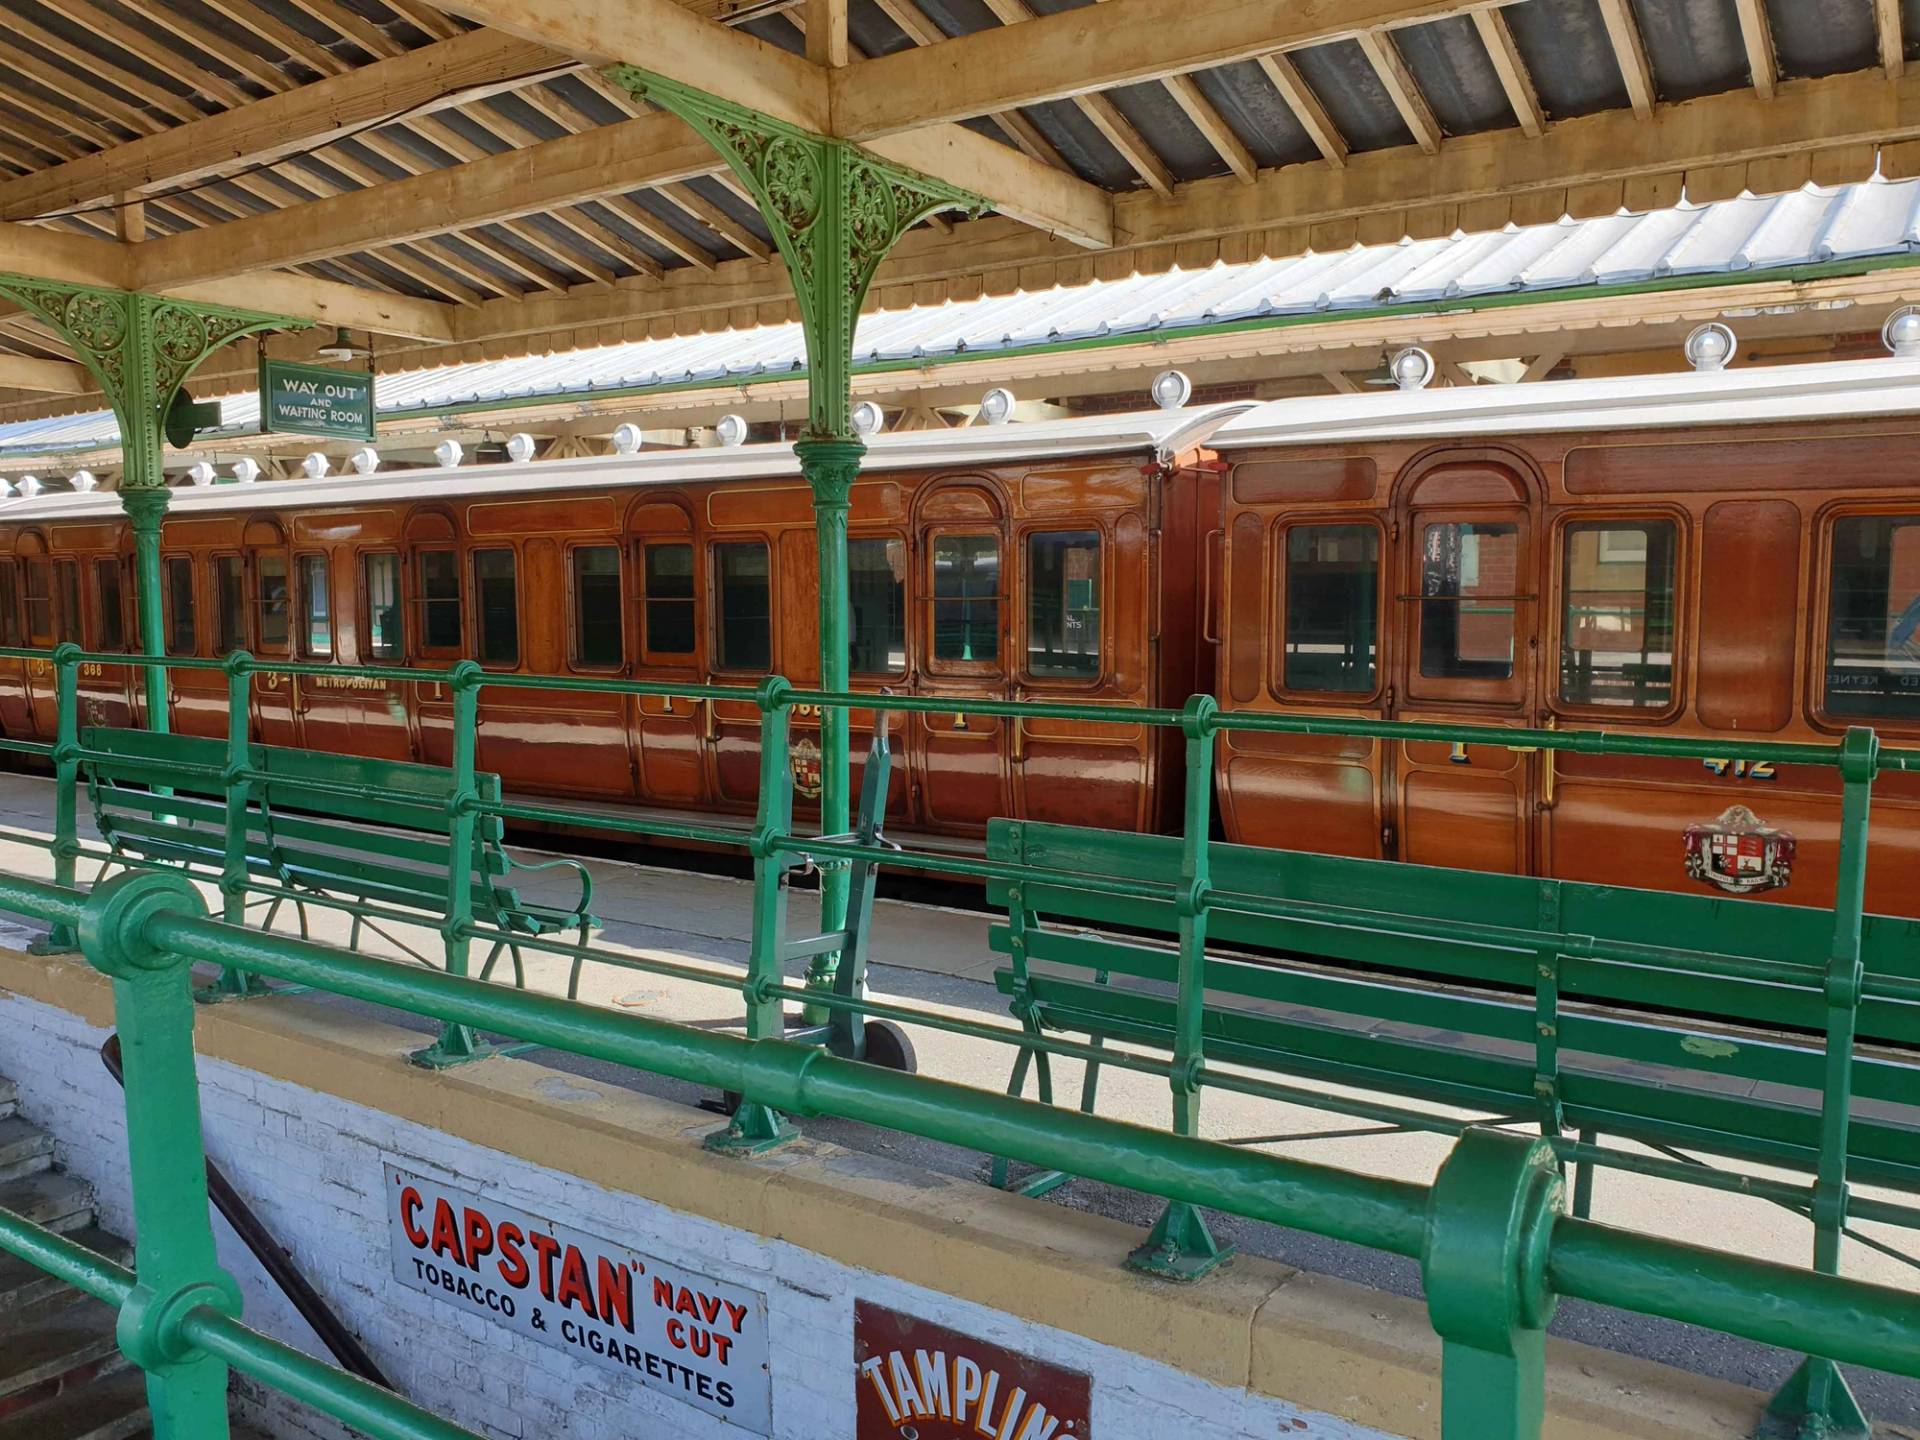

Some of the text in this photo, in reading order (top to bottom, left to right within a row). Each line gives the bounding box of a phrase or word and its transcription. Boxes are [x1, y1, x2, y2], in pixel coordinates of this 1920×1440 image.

[283, 379, 356, 399] WAY OUT
[310, 398, 332, 407] AND
[279, 404, 362, 424] WAITING ROOM
[316, 677, 387, 690] METROPOLITAN
[653, 1276, 748, 1334] NAVY
[412, 1257, 735, 1408] TOBACCO & CIGARETTES
[666, 1318, 733, 1366] CUT
[862, 1349, 1080, 1440] TAMPLIN
